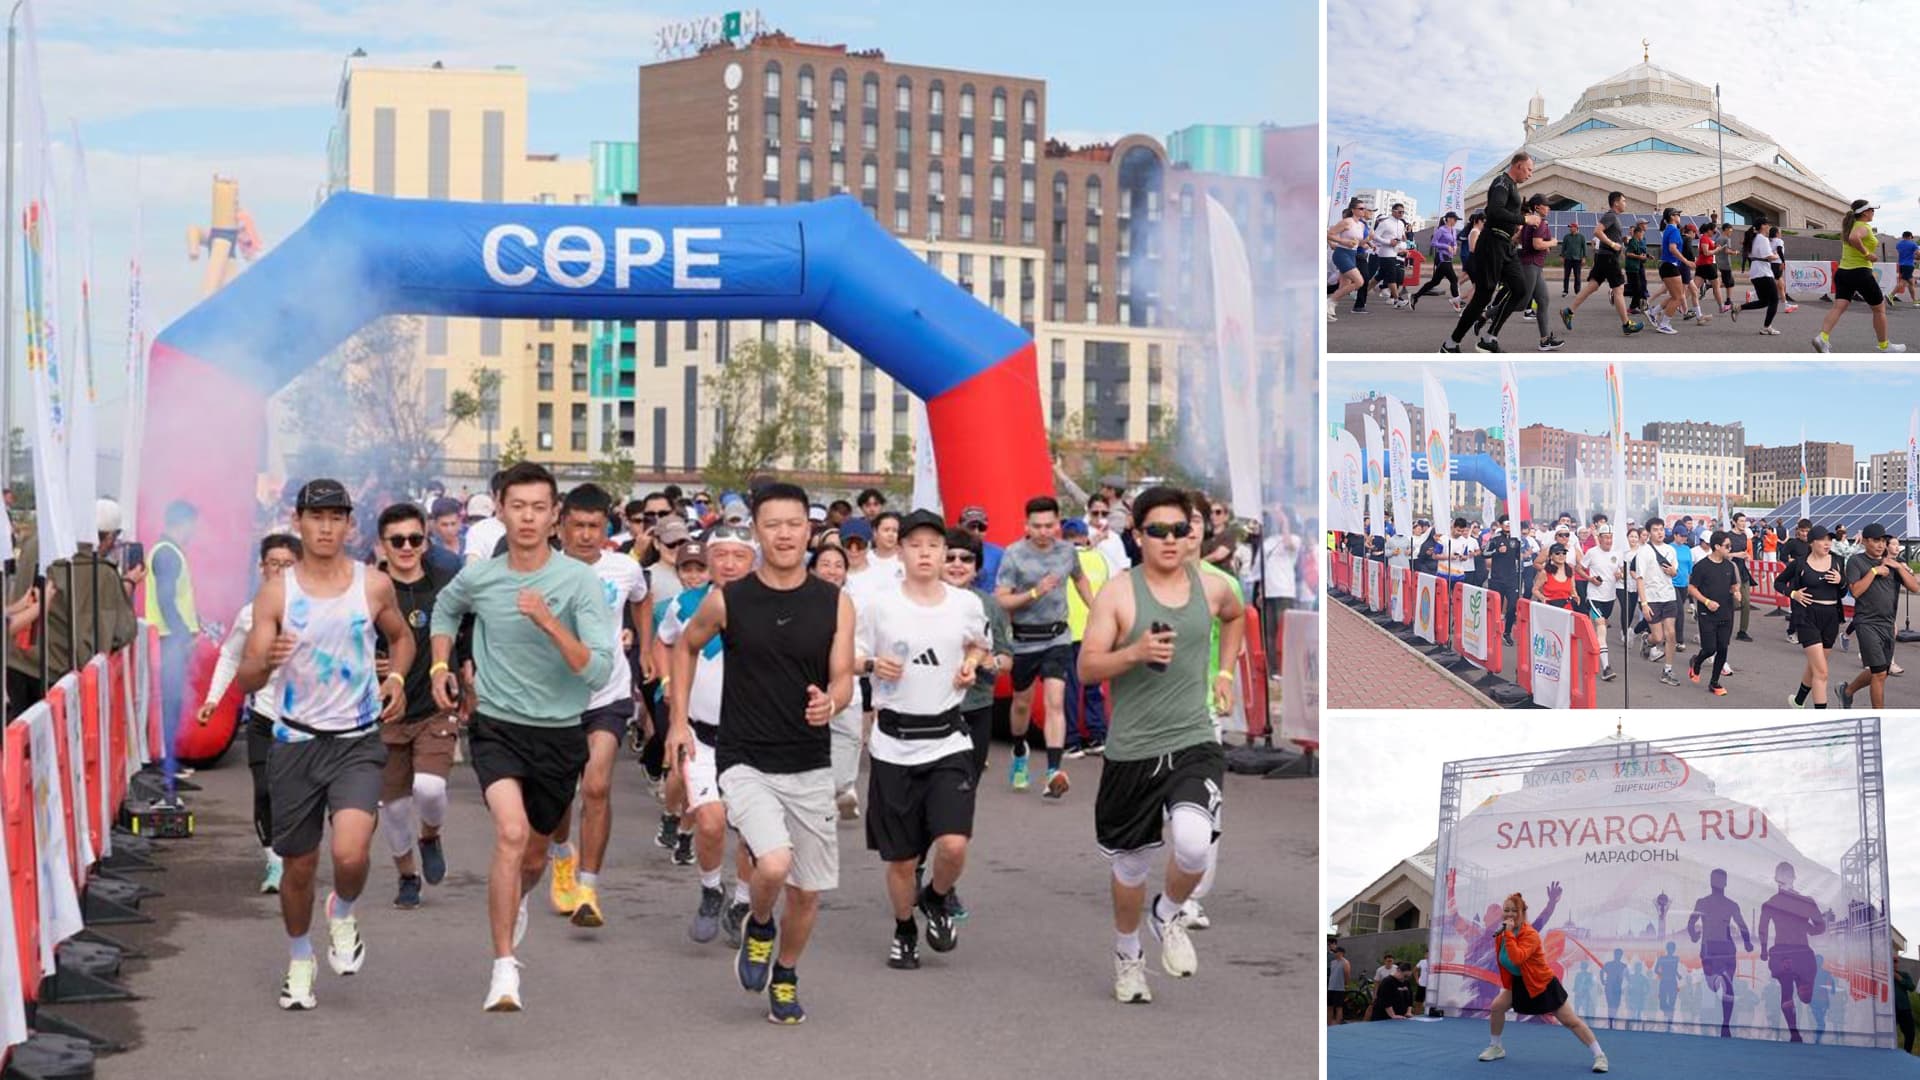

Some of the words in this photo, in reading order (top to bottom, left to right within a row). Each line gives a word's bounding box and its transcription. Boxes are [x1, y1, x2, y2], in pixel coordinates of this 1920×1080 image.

[483, 223, 723, 290] СӨРЕ
[1522, 767, 1600, 788] ARYARQA
[1497, 812, 1686, 849] SARYARQA
[1584, 849, 1680, 864] МАРАФОНЫ
